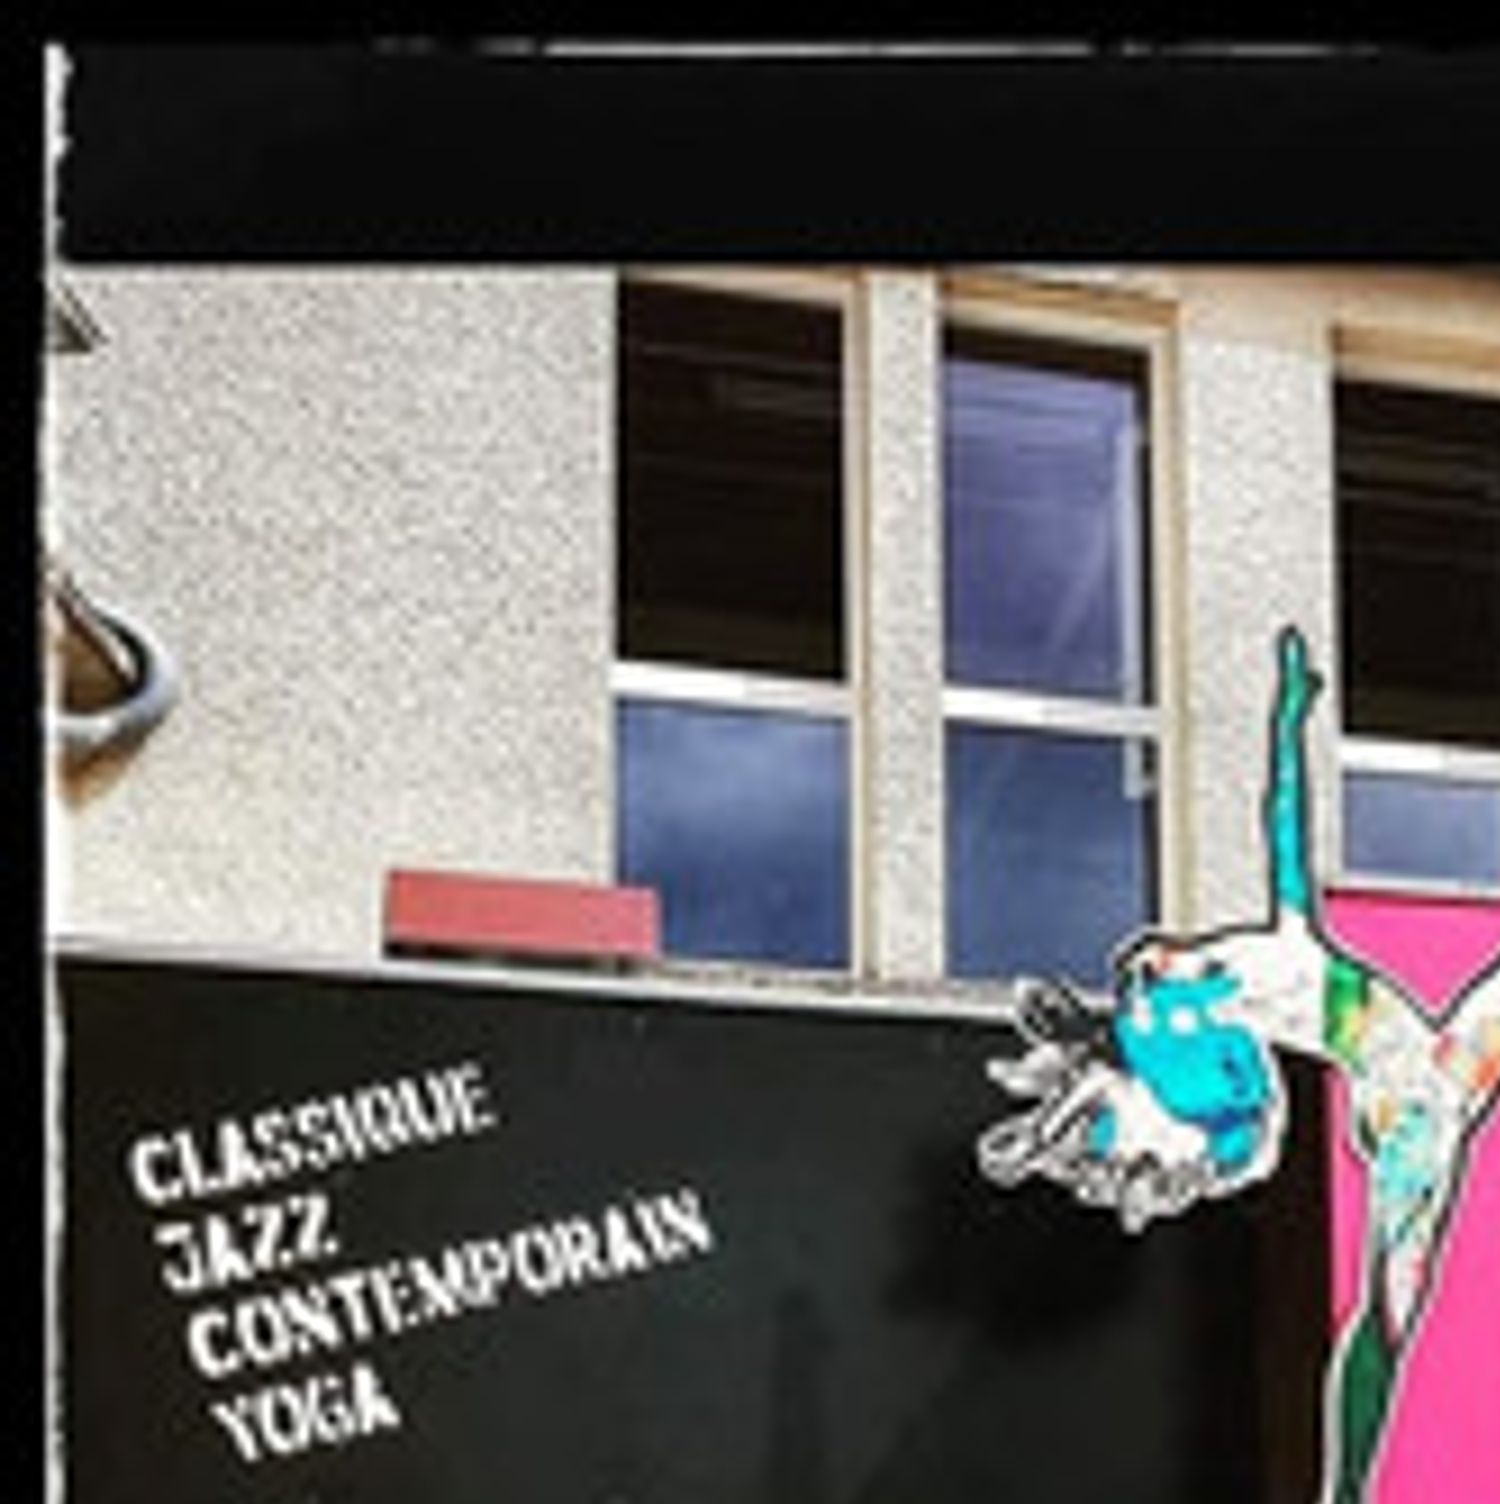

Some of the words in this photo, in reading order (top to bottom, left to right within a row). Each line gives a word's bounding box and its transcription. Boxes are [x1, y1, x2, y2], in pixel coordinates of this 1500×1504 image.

[131, 1063, 496, 1202] CLASSIQUE
[154, 1195, 338, 1291] JAZZ
[188, 1189, 712, 1377] CONTEMPORAIN
[211, 1363, 399, 1461] YOGA
